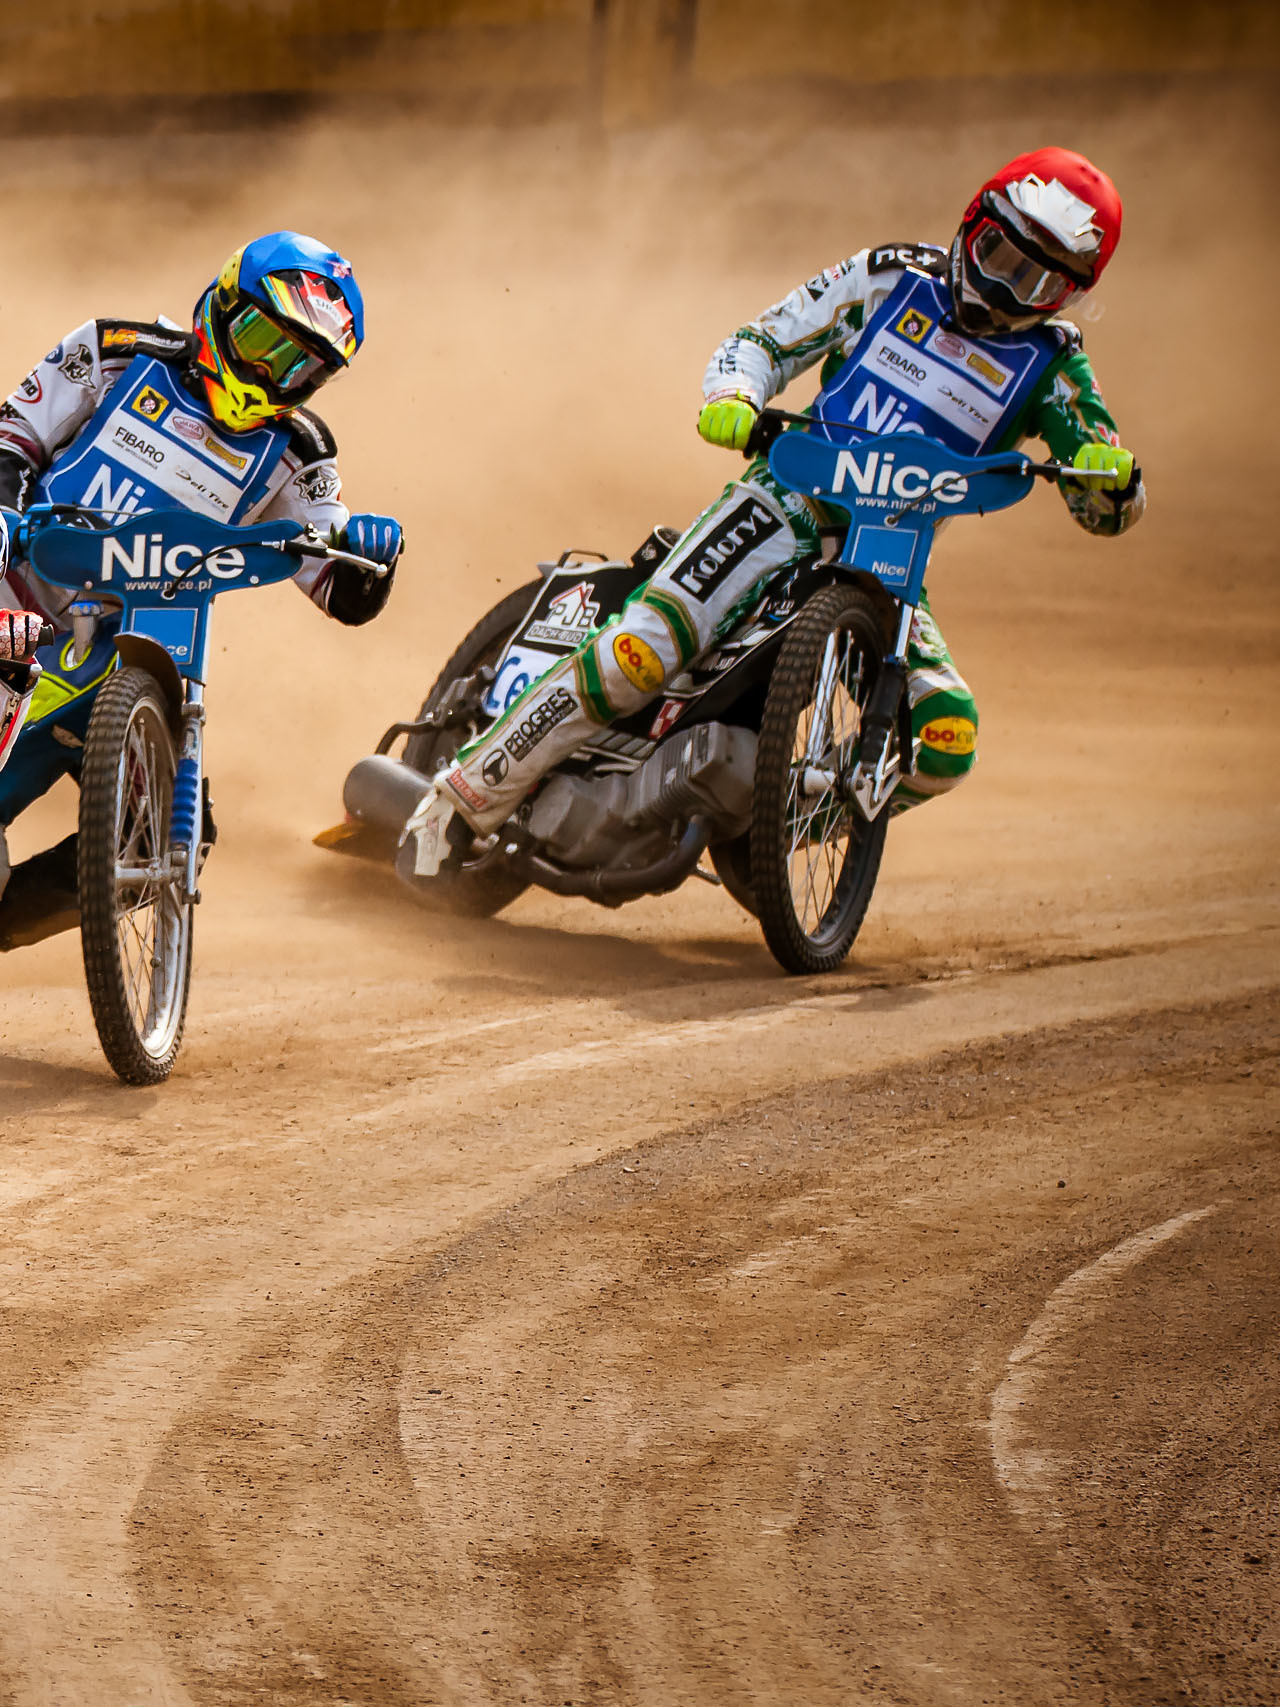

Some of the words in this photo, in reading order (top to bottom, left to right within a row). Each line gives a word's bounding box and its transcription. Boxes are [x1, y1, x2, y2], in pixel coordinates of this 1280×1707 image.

[879, 346, 926, 381] FIBARO
[115, 426, 165, 464] FIBARO
[832, 450, 968, 504] Nice
[208, 491, 229, 510] Tire
[101, 534, 246, 581] Nice
[681, 505, 773, 595] Koloryt
[124, 577, 213, 592] www.nce.pl
[871, 561, 907, 577] Nice
[166, 644, 188, 656] ce
[503, 687, 572, 753] PROGRES
